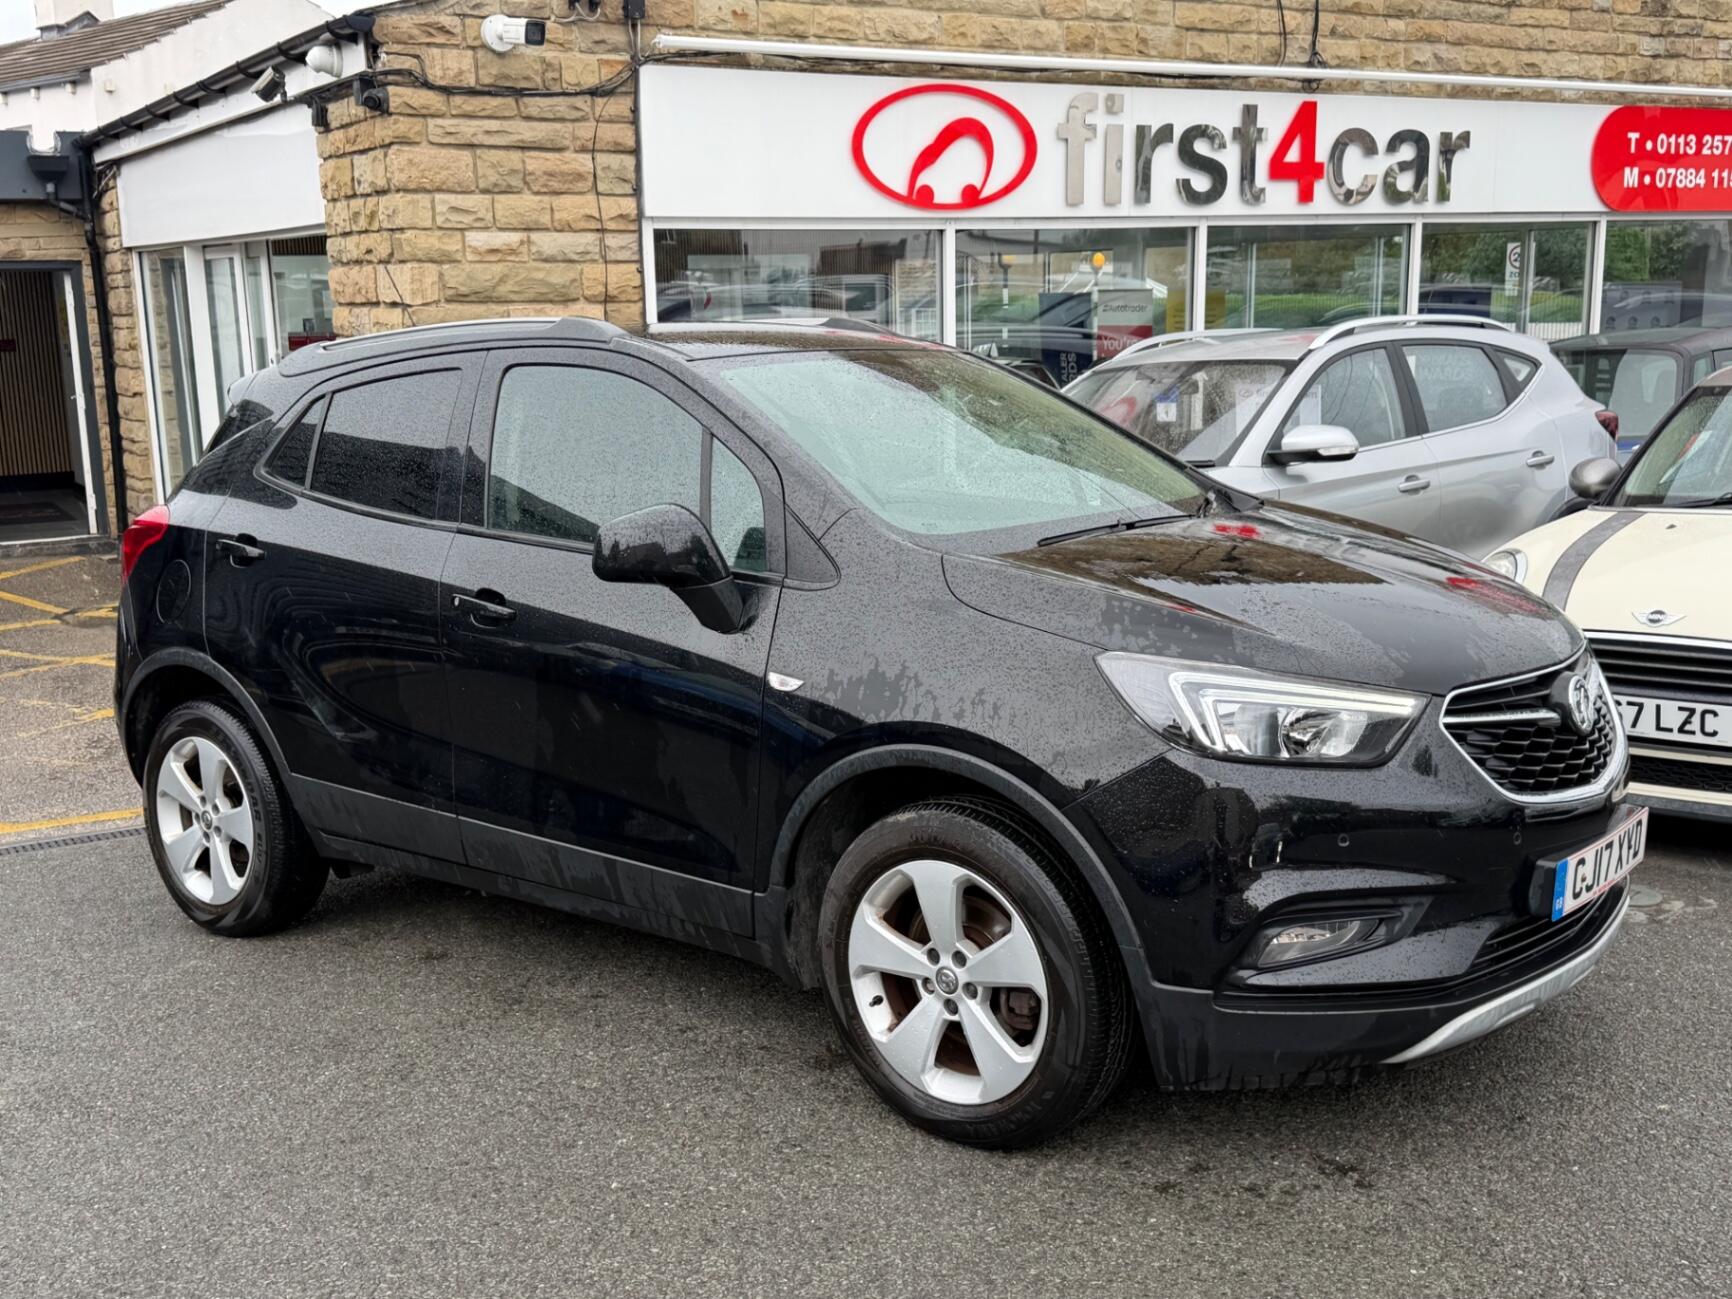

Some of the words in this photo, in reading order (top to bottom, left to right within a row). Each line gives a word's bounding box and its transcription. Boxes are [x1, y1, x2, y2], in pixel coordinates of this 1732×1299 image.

[1057, 92, 1471, 207] first4car
[1627, 131, 1640, 154] T
[1656, 132, 1697, 155] 0113
[1701, 134, 1732, 156] 257
[1623, 166, 1639, 189] M
[1655, 167, 1706, 189] 07884
[1711, 168, 1732, 189] 11
[1614, 700, 1645, 730] 7
[1655, 703, 1719, 738] LZC
[1572, 839, 1614, 901] CJ17
[1615, 818, 1643, 875] XYD
